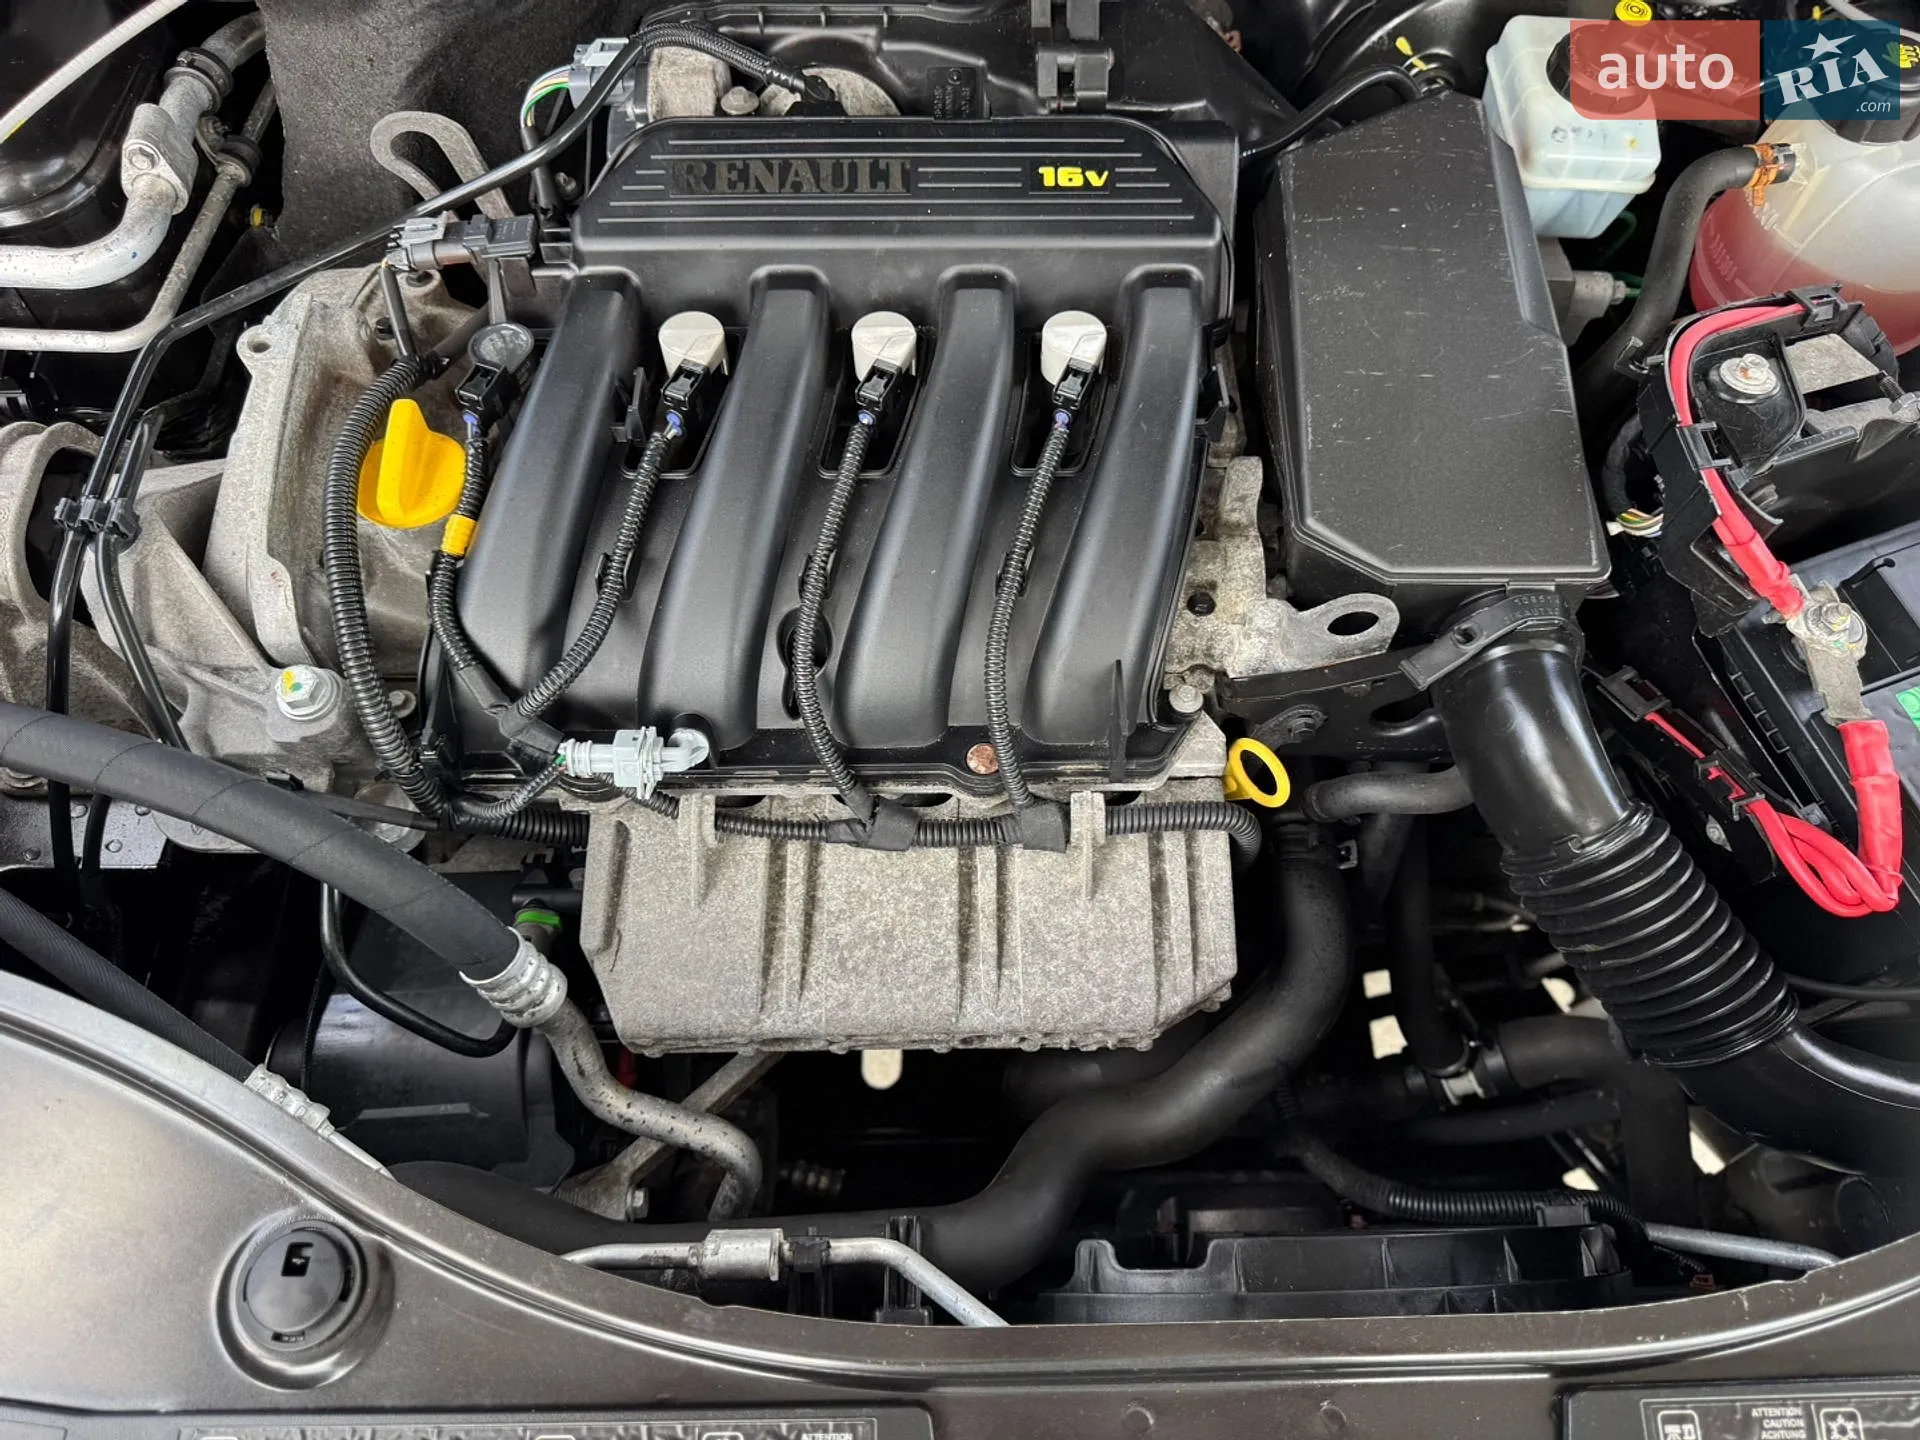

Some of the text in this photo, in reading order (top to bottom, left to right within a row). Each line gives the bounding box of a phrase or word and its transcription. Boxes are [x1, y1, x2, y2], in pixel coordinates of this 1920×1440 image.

[672, 158, 911, 194] RENAULT
[1751, 1407, 1803, 1417] ATTENTION
[1762, 1418, 1805, 1428] CAUTION
[1760, 1429, 1807, 1440] ACHTUNG
